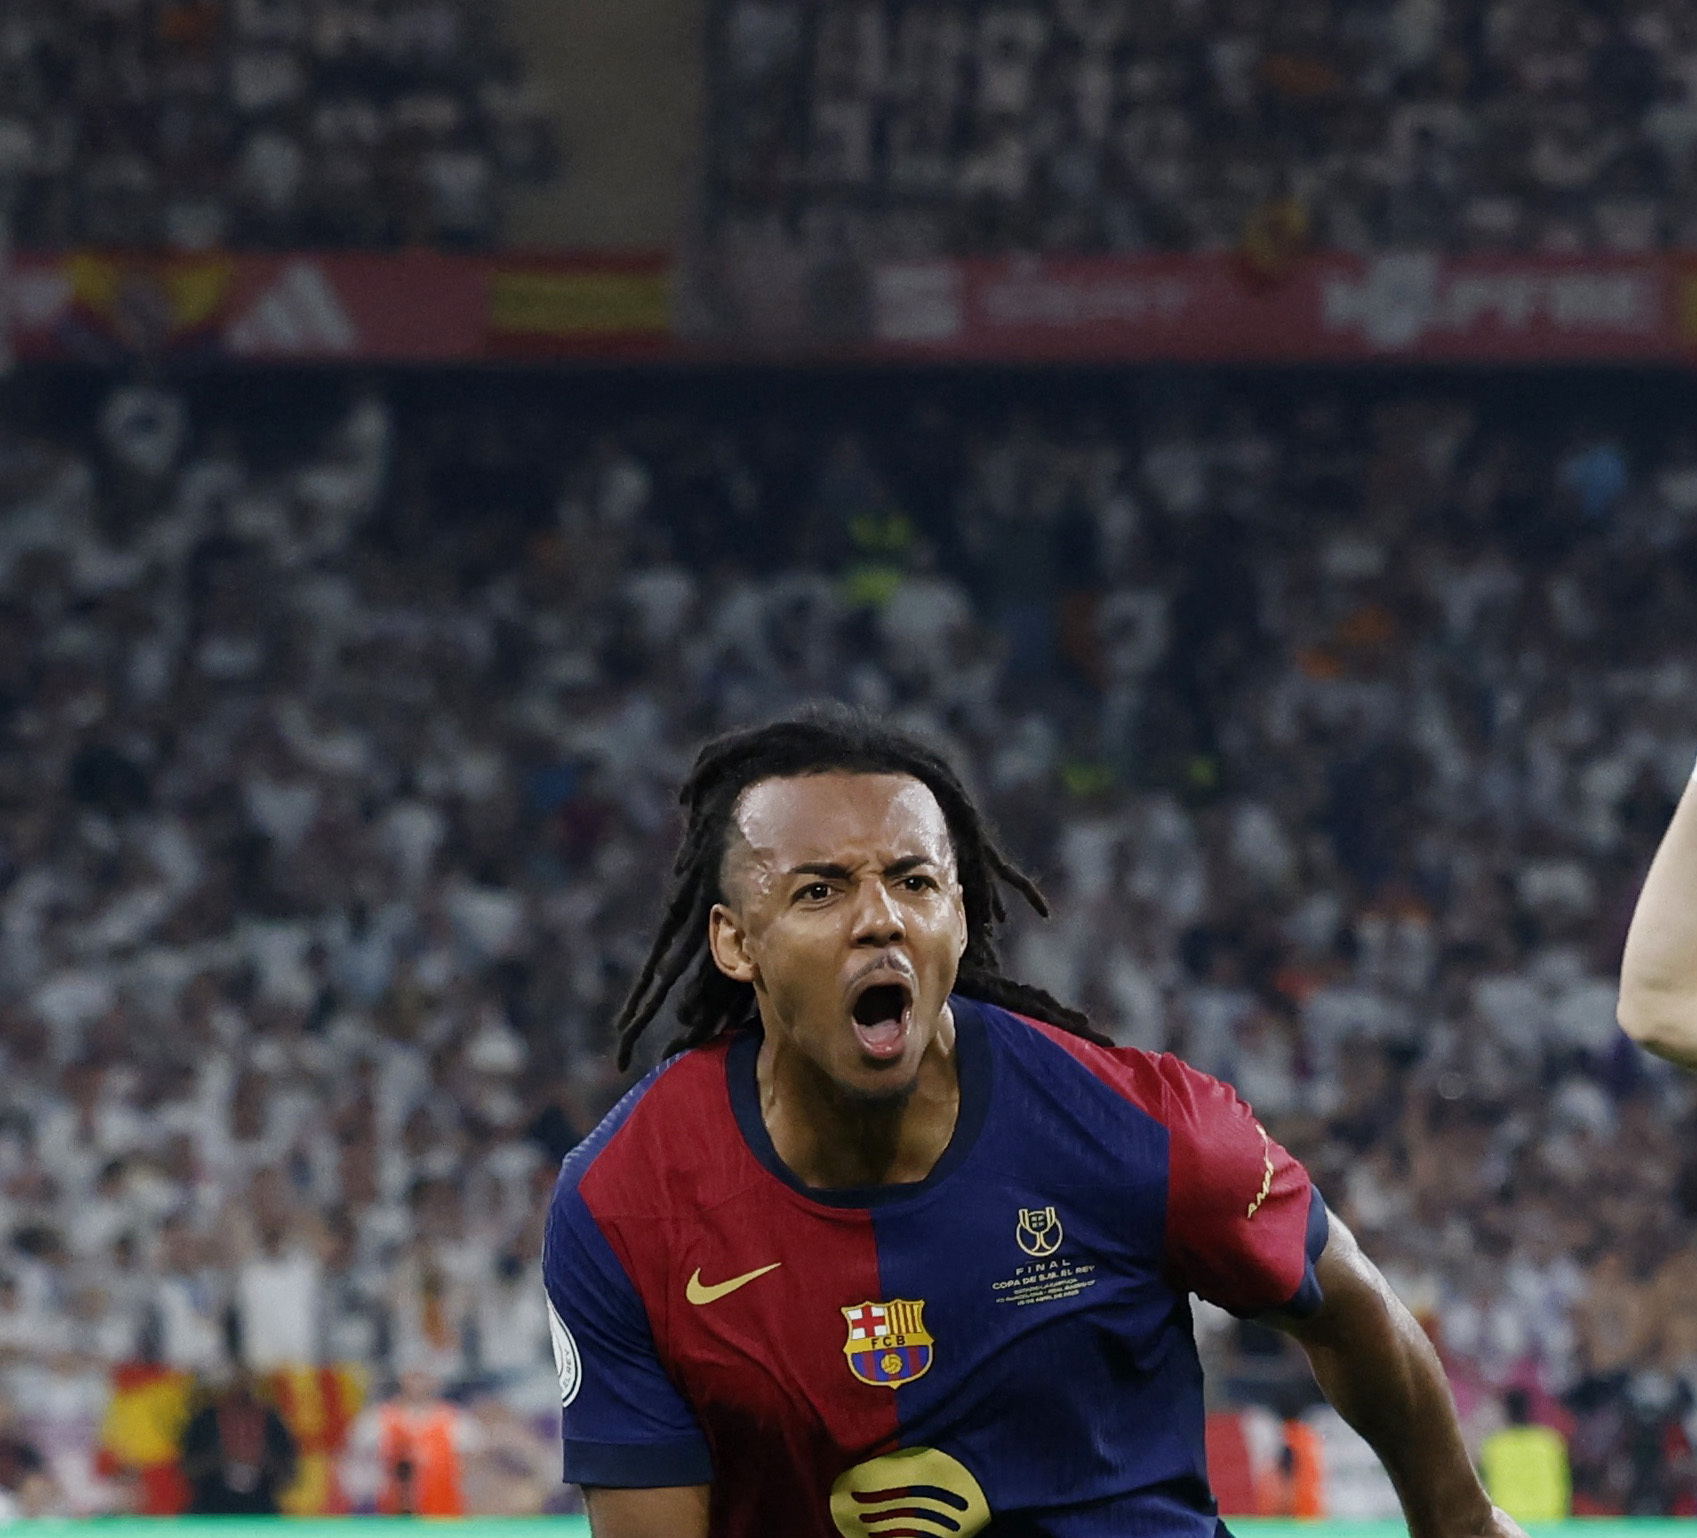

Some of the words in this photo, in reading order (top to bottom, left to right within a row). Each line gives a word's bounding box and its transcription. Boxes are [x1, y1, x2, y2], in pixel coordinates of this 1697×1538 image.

[992, 1279, 1021, 1290] COPA
[1022, 1276, 1037, 1284] DE
[1075, 1265, 1095, 1274] REY
[1015, 1259, 1071, 1276] FINAL
